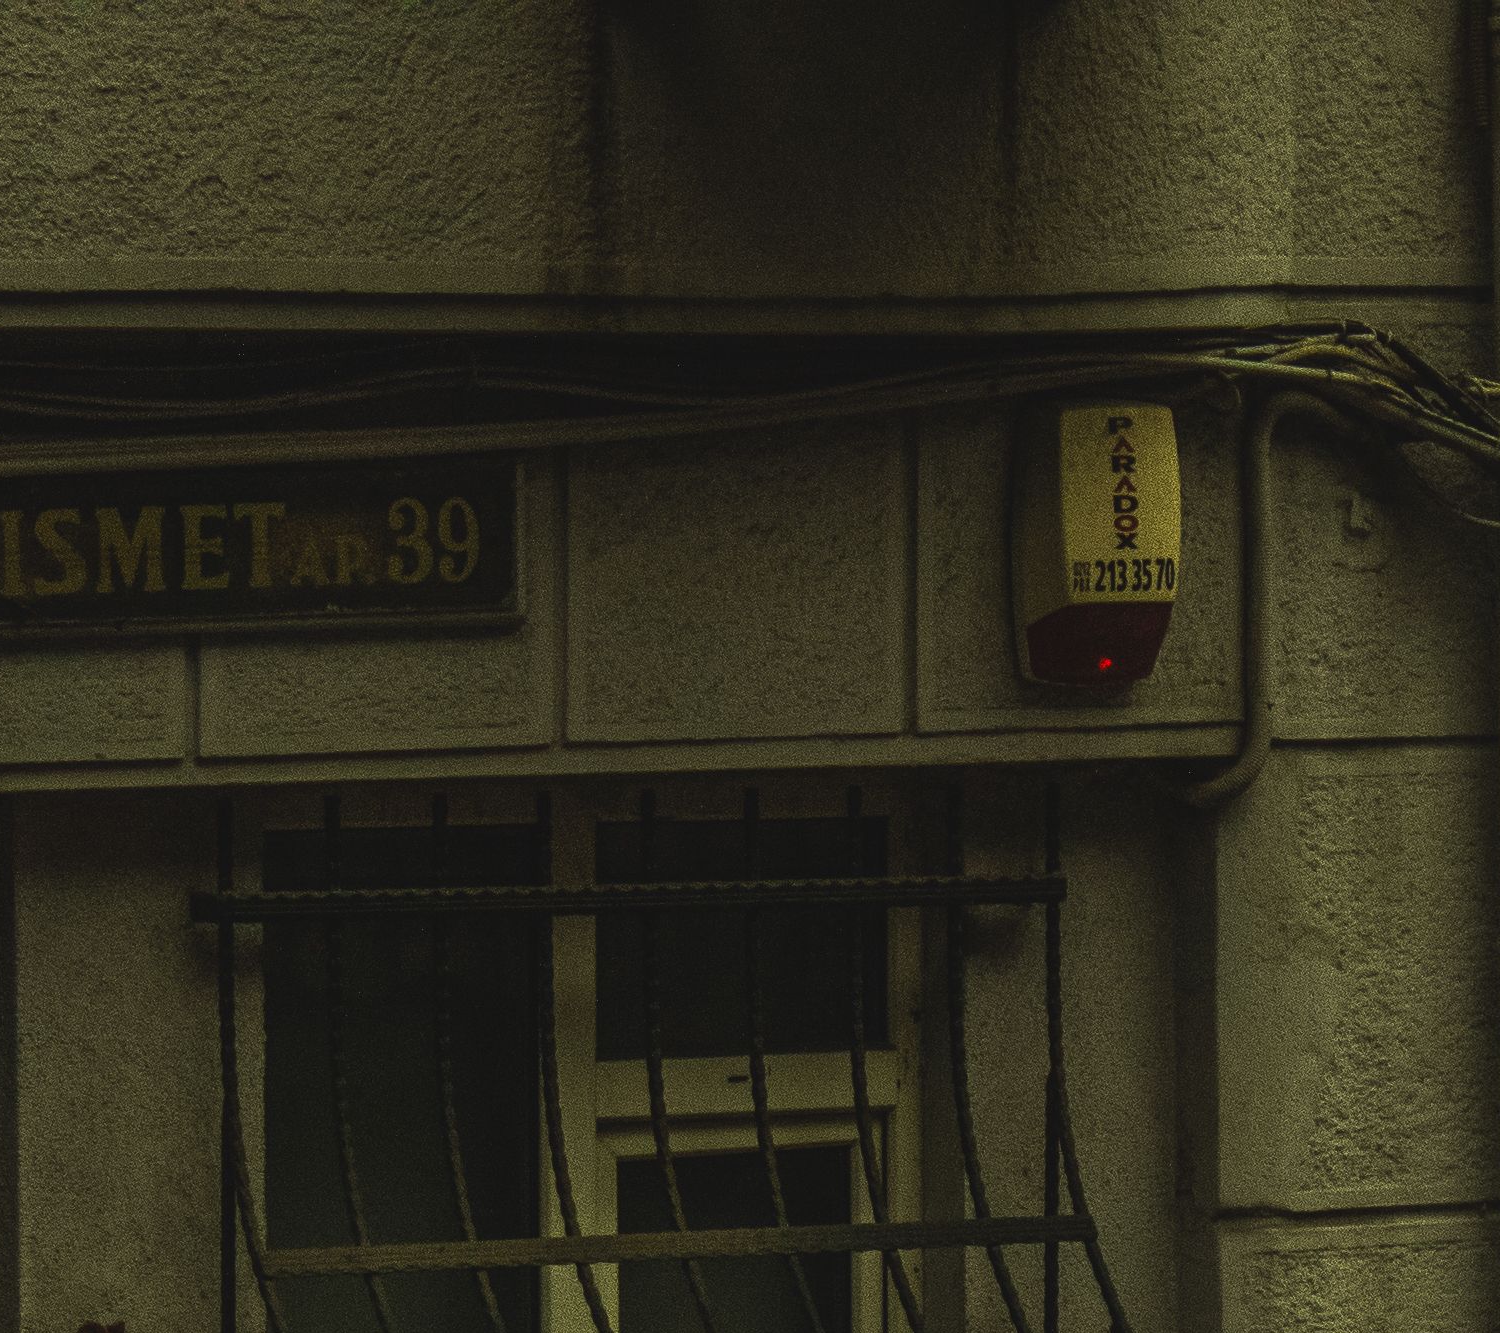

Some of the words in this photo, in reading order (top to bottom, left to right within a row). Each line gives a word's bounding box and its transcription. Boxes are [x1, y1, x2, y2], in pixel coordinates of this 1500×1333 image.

[1107, 416, 1139, 549] PARADOX
[387, 497, 480, 584] 39
[1095, 559, 1128, 592] 213
[1132, 558, 1152, 591] 35
[1155, 557, 1175, 591] 70
